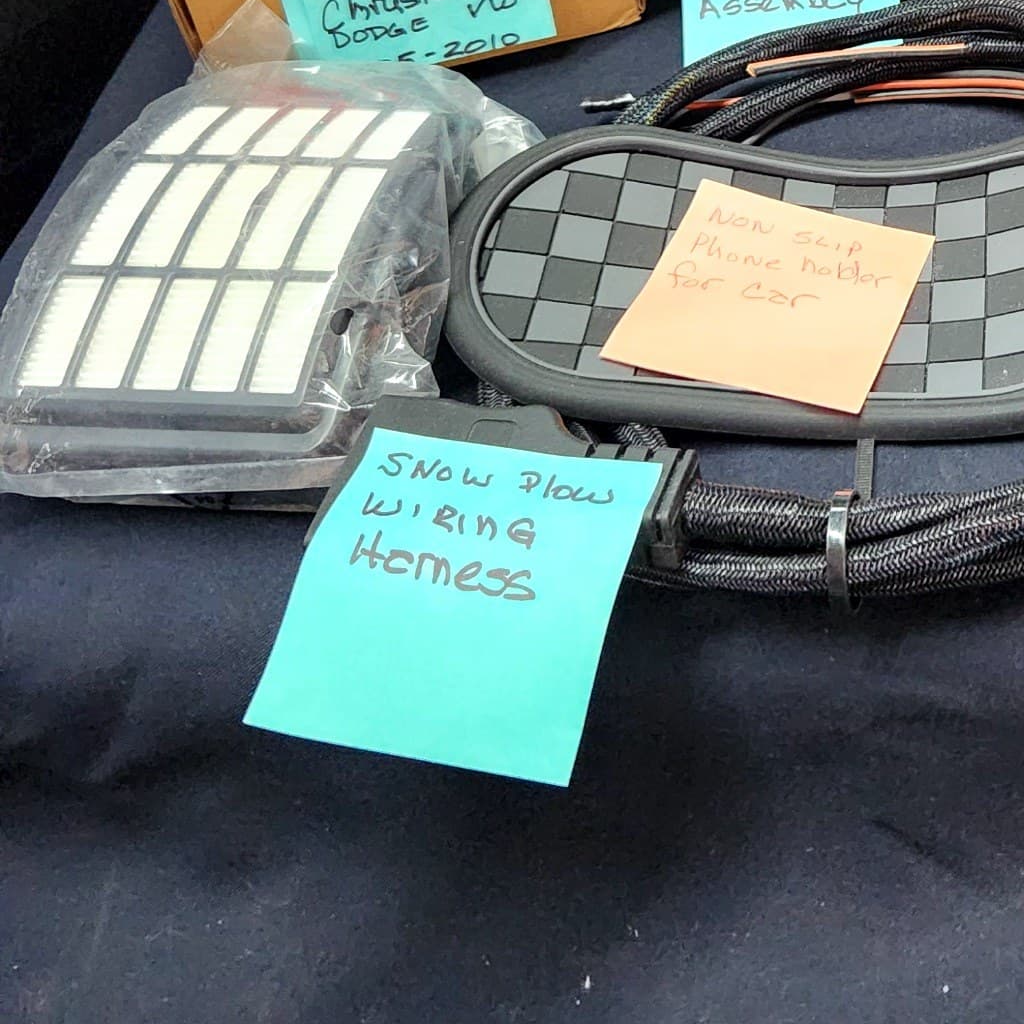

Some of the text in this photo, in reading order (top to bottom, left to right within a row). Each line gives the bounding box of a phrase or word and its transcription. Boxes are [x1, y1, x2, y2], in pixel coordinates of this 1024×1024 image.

[326, 16, 430, 50] DODGE
[707, 207, 777, 236] NON
[667, 259, 726, 292] for
[376, 450, 496, 490] SNOW
